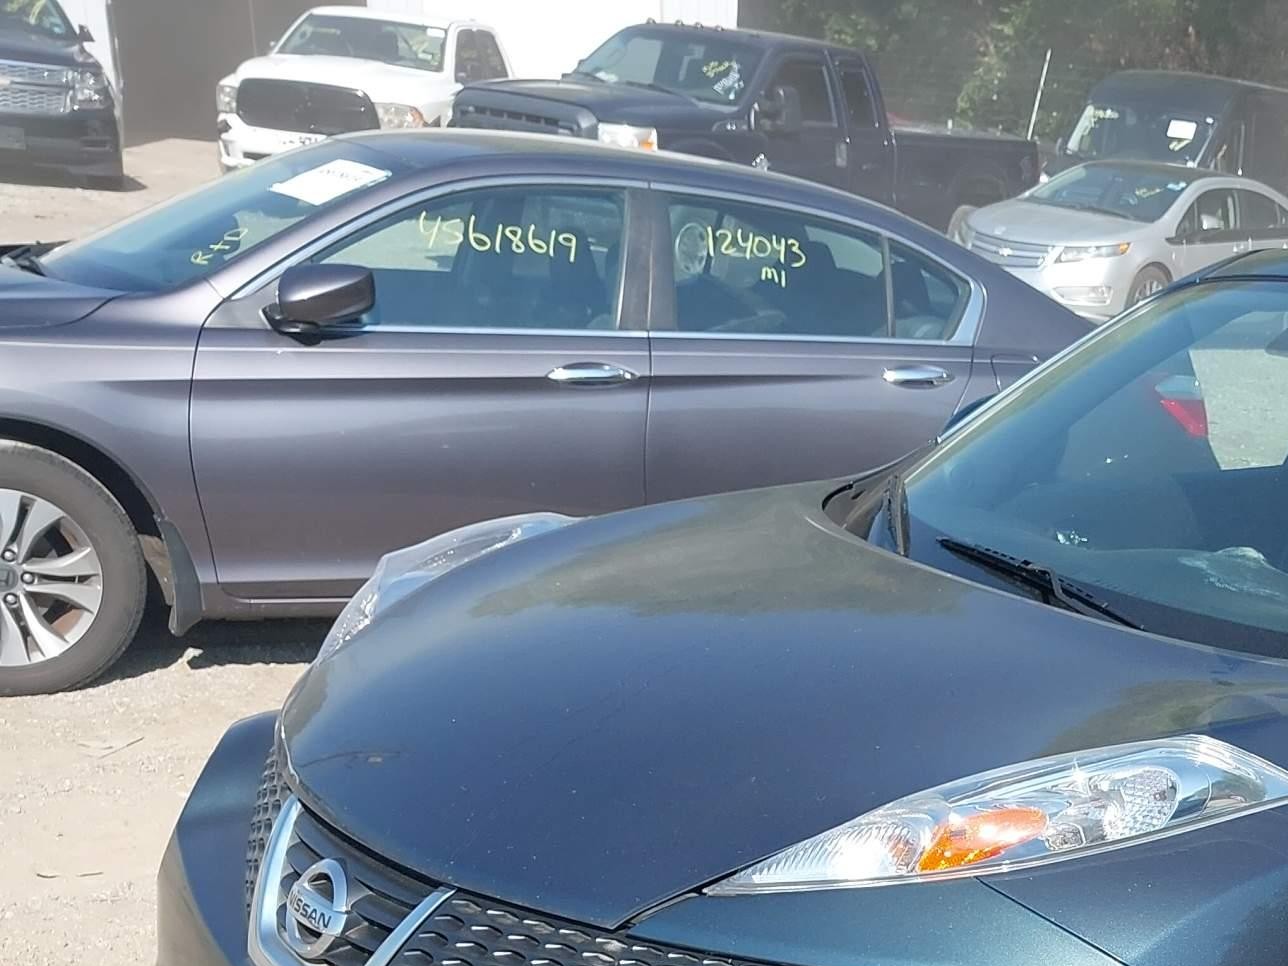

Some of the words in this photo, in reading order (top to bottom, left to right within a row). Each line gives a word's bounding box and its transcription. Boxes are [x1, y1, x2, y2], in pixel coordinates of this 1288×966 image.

[419, 210, 577, 263] 45618619
[706, 226, 806, 267] 124043
[288, 889, 332, 929] NISSAN
